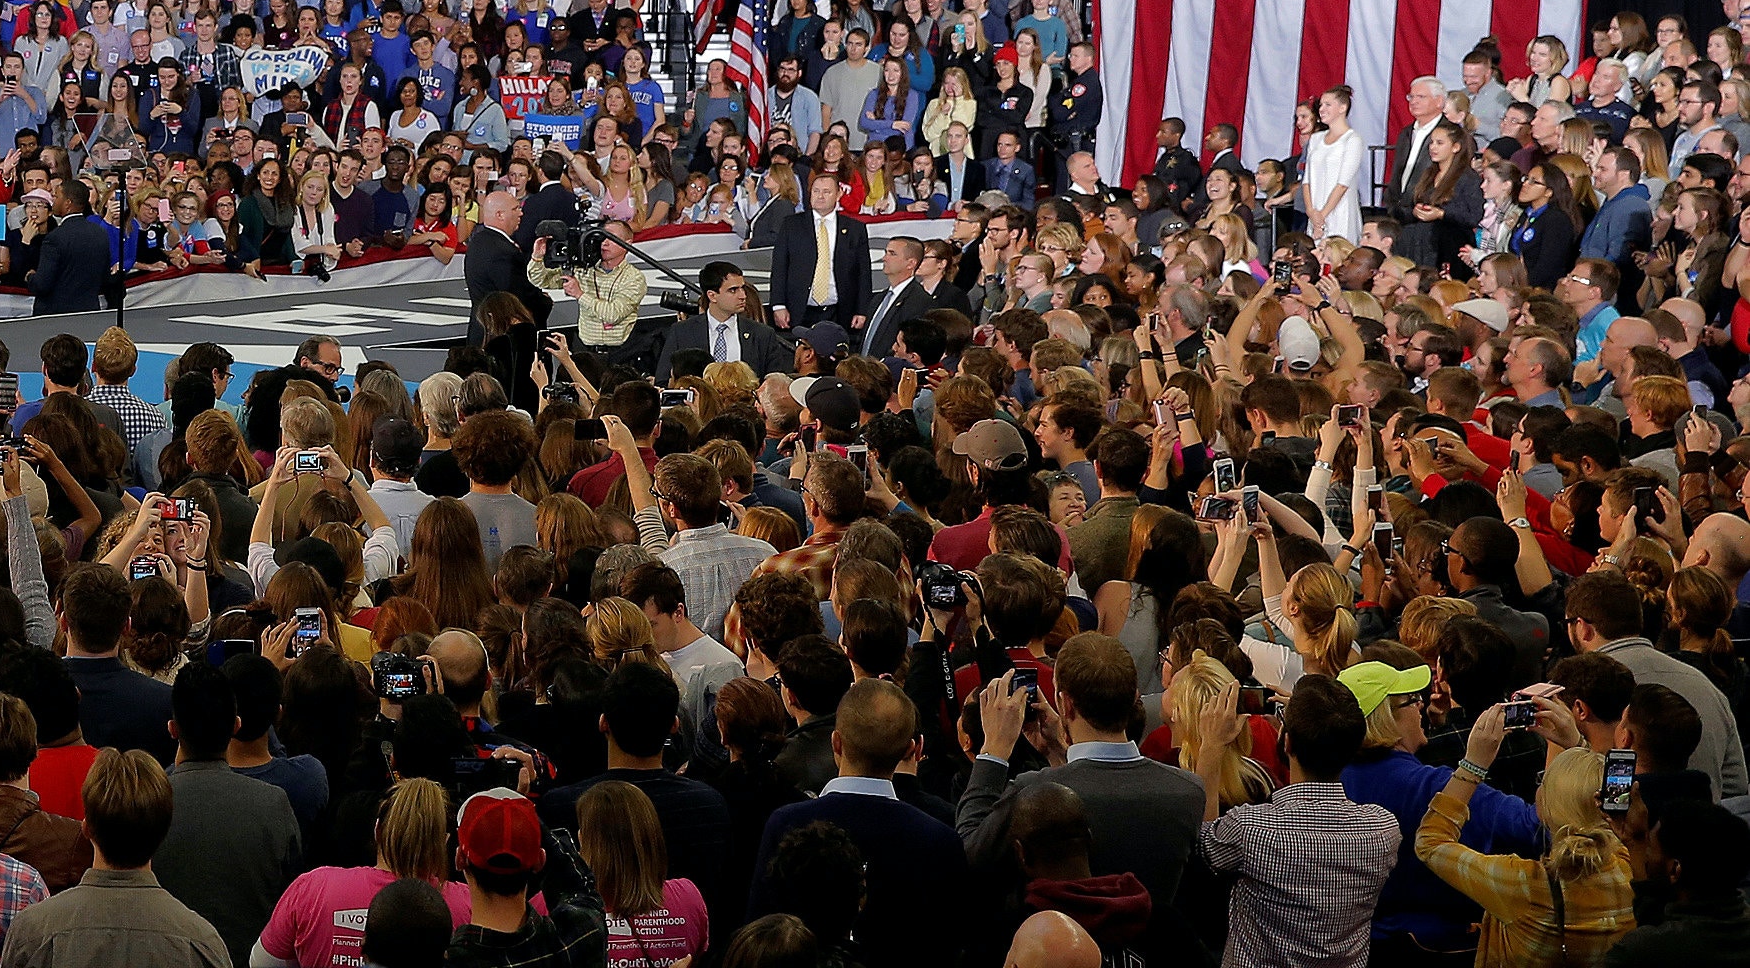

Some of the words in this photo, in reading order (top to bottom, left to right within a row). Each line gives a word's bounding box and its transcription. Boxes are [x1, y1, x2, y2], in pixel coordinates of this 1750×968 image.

[246, 49, 325, 76] CAROLINA
[419, 76, 441, 88] UKE
[501, 77, 552, 95] HILLA
[527, 122, 580, 134] STRONGER
[634, 917, 686, 927] PARENTHOOD
[635, 927, 664, 936] ACTION
[332, 938, 360, 948] Planned
[612, 942, 649, 951] Parenthod
